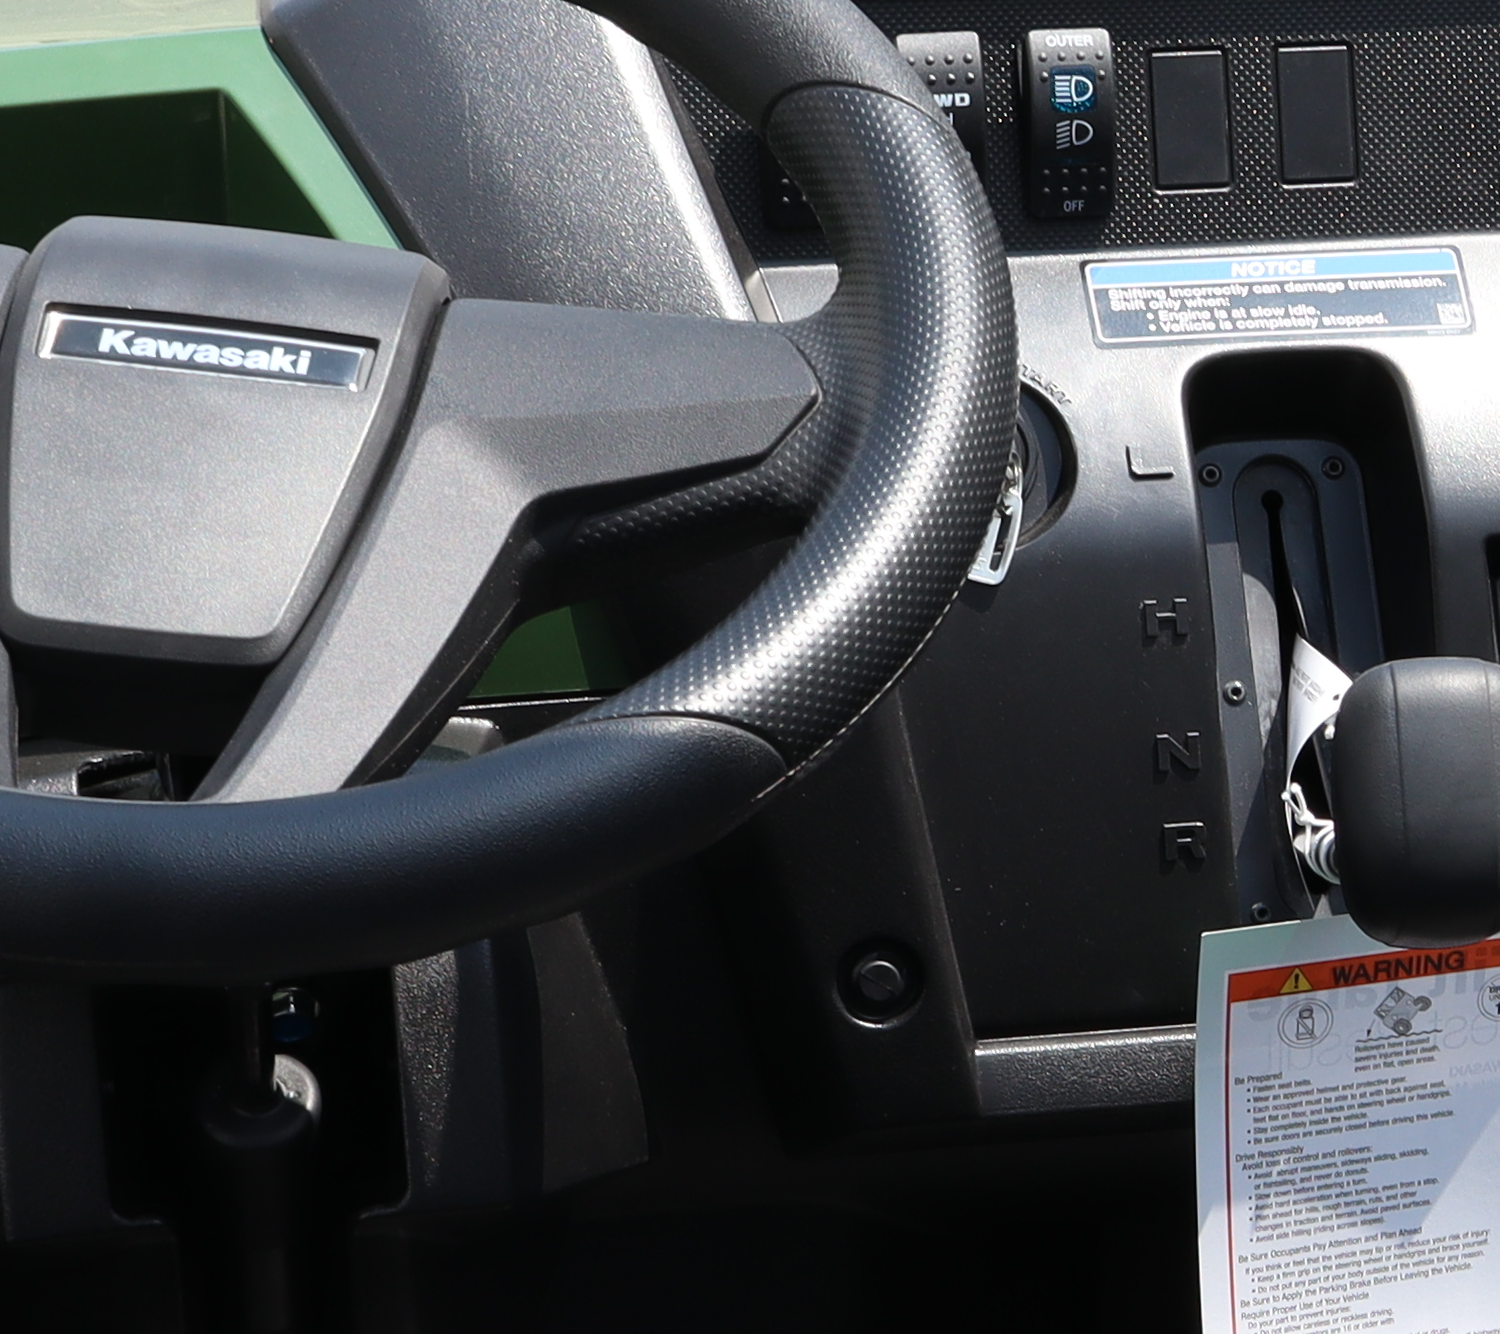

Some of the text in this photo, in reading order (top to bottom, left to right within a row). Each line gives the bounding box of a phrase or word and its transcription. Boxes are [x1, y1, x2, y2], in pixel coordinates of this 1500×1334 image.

[1045, 34, 1094, 47] OUTER
[932, 93, 972, 107] WD
[1063, 200, 1085, 212] OFF
[1230, 259, 1316, 277] NOTICE
[1108, 275, 1446, 302] Shifting incorrectly can damage transmission.
[1110, 296, 1230, 311] Shift only when:
[1158, 304, 1319, 323] Engine is at slow idle.
[1160, 312, 1387, 332] Vehicle is completely stopped.
[98, 328, 312, 375] Kawasaki
[1019, 363, 1073, 407] TART
[1125, 445, 1176, 482] L
[1143, 597, 1188, 638] H
[1156, 731, 1200, 772] N
[1163, 821, 1206, 862] R
[1332, 951, 1464, 983] WARNING
[1247, 1072, 1282, 1084] Prepared
[1235, 1145, 1304, 1162] Drive Responsibly
[1238, 1226, 1421, 1263] Be Sure Occupants Pay Attention and Plan Ahead
[1240, 1261, 1472, 1307] Be Sure to Apply the Parking Brake Before Leaving the Vehicle.
[1241, 1291, 1369, 1321] Require Proper Use of Your Vehicle
